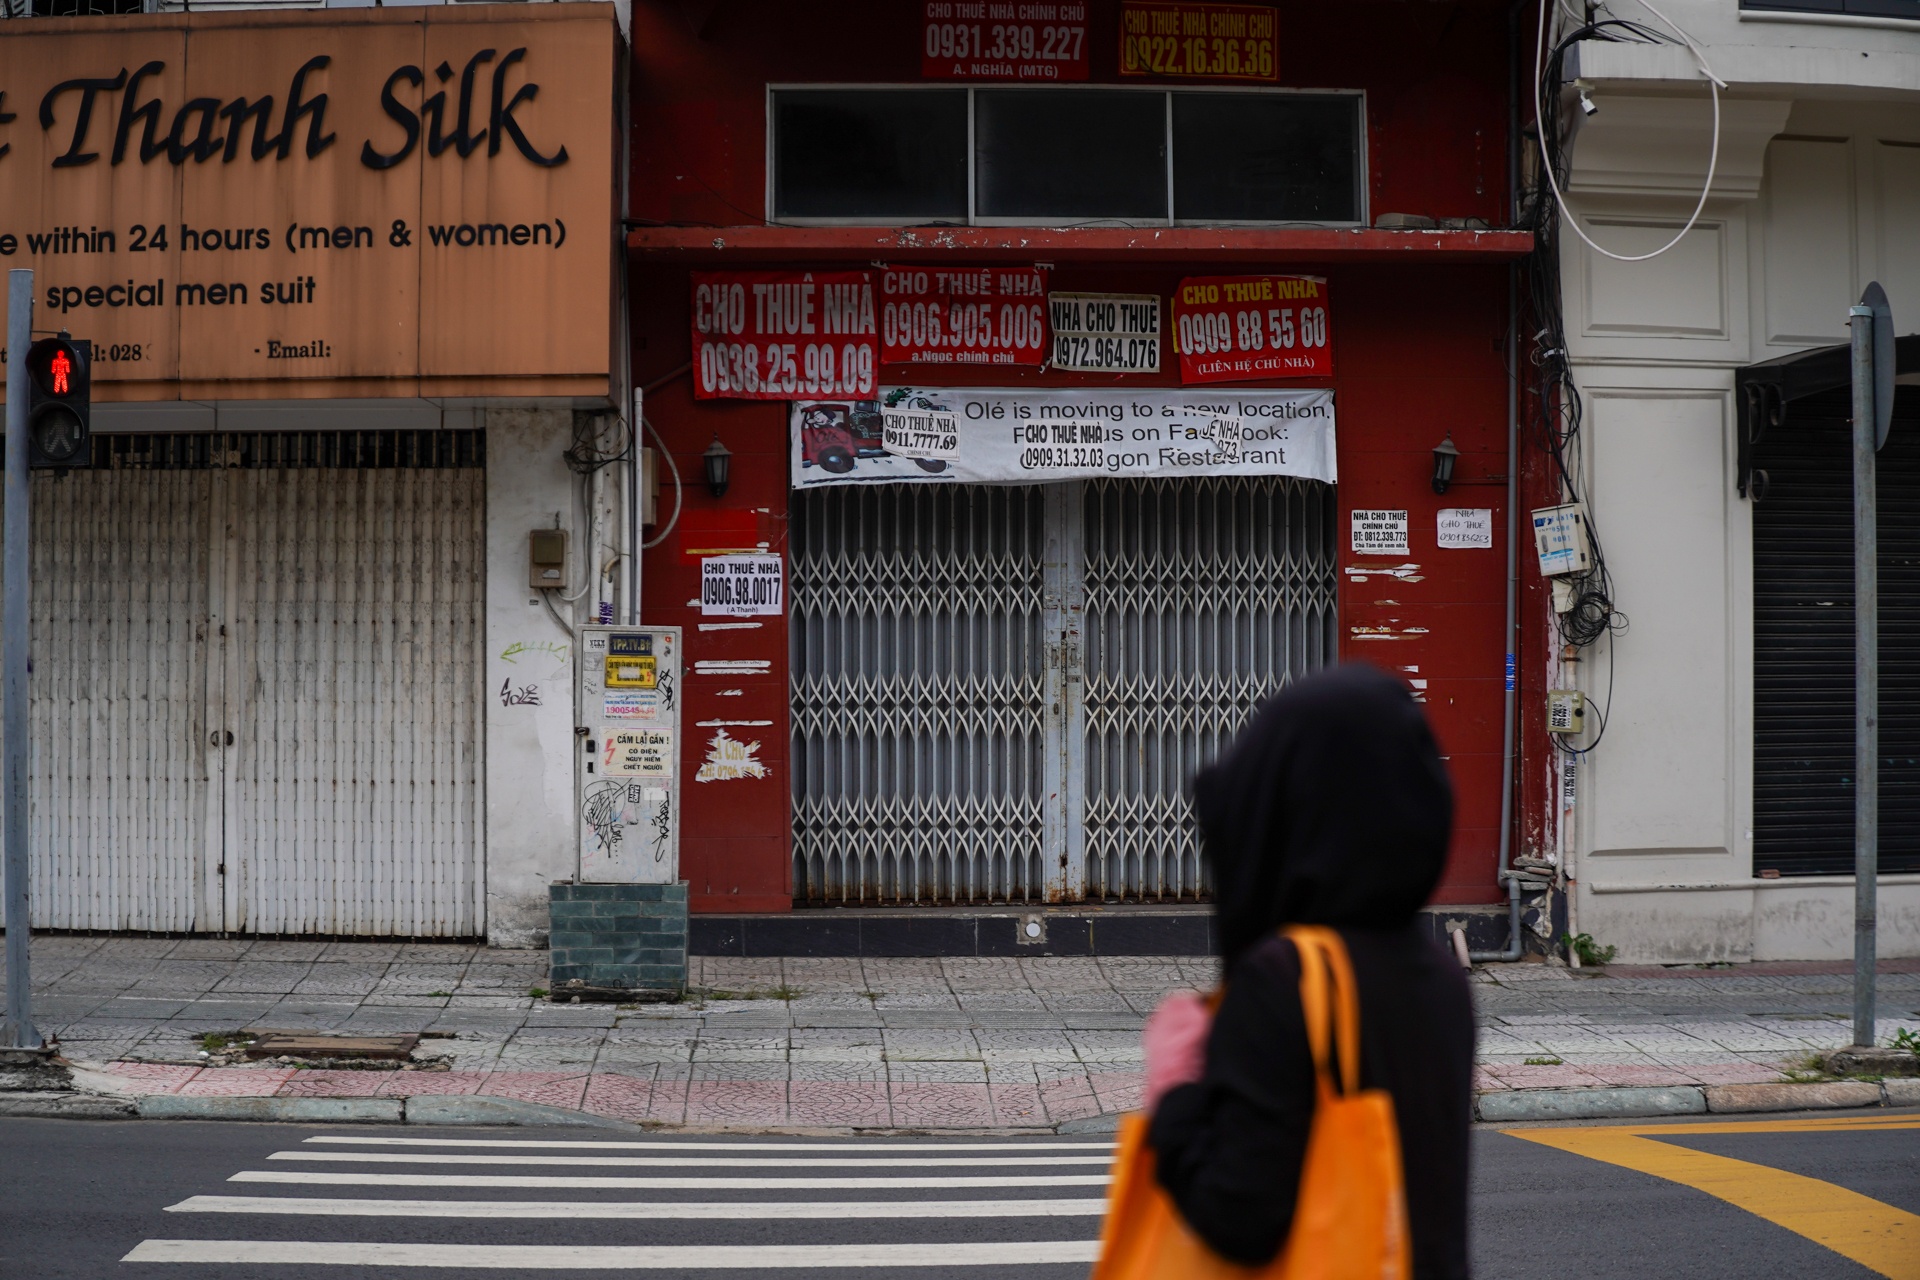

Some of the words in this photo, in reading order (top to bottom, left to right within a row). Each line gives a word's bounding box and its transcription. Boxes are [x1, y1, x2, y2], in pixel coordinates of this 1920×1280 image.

[927, 2, 952, 19] CHO
[955, 0, 986, 20] THUÊ
[989, 1, 1016, 20] NHÀ
[1018, 2, 1056, 21] CHÍNH
[1058, 0, 1085, 21] CHỦ
[1124, 9, 1148, 34] CHO
[1151, 8, 1180, 36] THUÊ
[1182, 9, 1207, 37] NHÀ
[1209, 9, 1246, 39] CHÍNH
[1248, 9, 1273, 39] CHỦ
[925, 23, 1085, 61] 0931.339.227
[1124, 35, 1273, 77] 0922.16.36.36
[953, 64, 967, 75] A.
[970, 62, 1014, 77] NGHĨA
[1018, 64, 1059, 79] (MTG)
[39, 55, 336, 168] Thanh
[360, 47, 570, 170] Silk
[27, 225, 115, 255] within
[128, 224, 168, 251] 24
[181, 223, 270, 251] hours
[285, 222, 373, 253] (men
[389, 219, 412, 248] &
[429, 217, 567, 249] women)
[883, 271, 928, 294] CHO
[935, 268, 992, 296] THUÊ
[999, 269, 1044, 296] NHÀ
[1183, 284, 1219, 305] CHO
[1223, 277, 1273, 303] THUÊ
[46, 279, 164, 314] special
[176, 282, 247, 306] men
[260, 276, 316, 304] suit
[695, 283, 745, 336] CHO
[752, 273, 816, 336] THUÊ
[823, 273, 876, 335] NHÀ
[883, 302, 1043, 349] 0906.905.006
[1052, 296, 1081, 332] NHÀ
[1085, 303, 1116, 333] CHO
[1120, 298, 1158, 333] THUÊ
[1179, 311, 1232, 356] 0909
[1236, 309, 1264, 352] 88
[1267, 308, 1295, 350] 55
[1300, 306, 1326, 348] 60
[109, 344, 142, 361] 028
[267, 340, 331, 360] Email:
[956, 351, 989, 363] chính
[992, 351, 1015, 364] chủ
[1055, 337, 1157, 369] 0972.964.076
[700, 342, 873, 394] 0938.25.99.09
[1197, 359, 1232, 376] (LIÊN
[1234, 357, 1252, 373] HỆ
[1254, 355, 1281, 371] CHỦ
[1284, 354, 1316, 369] NHÀ)
[964, 400, 1005, 420] Olé
[1013, 402, 1032, 419] is
[1040, 401, 1124, 422] moving
[1131, 402, 1153, 418] to
[1161, 405, 1175, 417] a
[1238, 401, 1331, 421] location.
[885, 414, 906, 429] CHO
[908, 413, 934, 432] THUÊ
[936, 414, 957, 433] NHÀ
[1025, 424, 1048, 443] CHO
[1051, 421, 1077, 444] THUÊ
[1080, 421, 1103, 444] NHÀ
[1132, 427, 1160, 441] on
[1218, 418, 1240, 440] NHÀ
[885, 429, 957, 450] 0911.7777.69
[1025, 447, 1104, 467] 0909.31.32.03
[1353, 511, 1369, 521] NHÀ
[1371, 512, 1386, 521] CHO
[1388, 511, 1407, 521] THUÊ
[1362, 522, 1383, 530] CHÍNH
[1354, 531, 1364, 542] ĐT:
[1364, 531, 1407, 542] 0812.339.773
[704, 563, 725, 574] CHO
[728, 561, 755, 574] THUÊ
[758, 561, 780, 574] NHÀ
[704, 577, 781, 605] 0906.98.0017
[617, 733, 634, 746] CẤM
